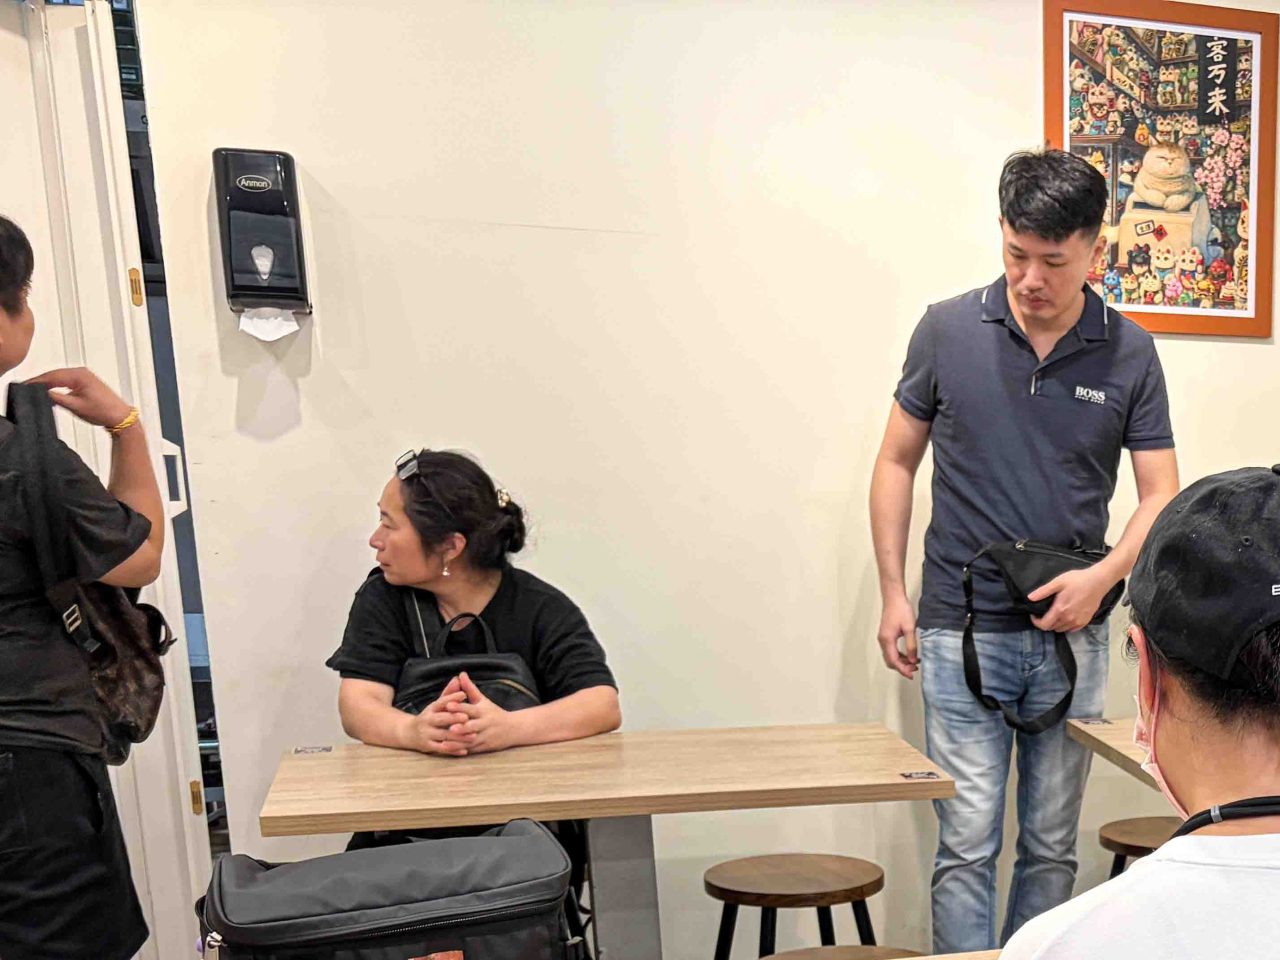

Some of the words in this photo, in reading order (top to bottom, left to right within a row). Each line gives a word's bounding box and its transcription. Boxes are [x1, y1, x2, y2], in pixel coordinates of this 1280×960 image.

[1206, 36, 1230, 116] 客万来
[1075, 386, 1106, 401] BOSS
